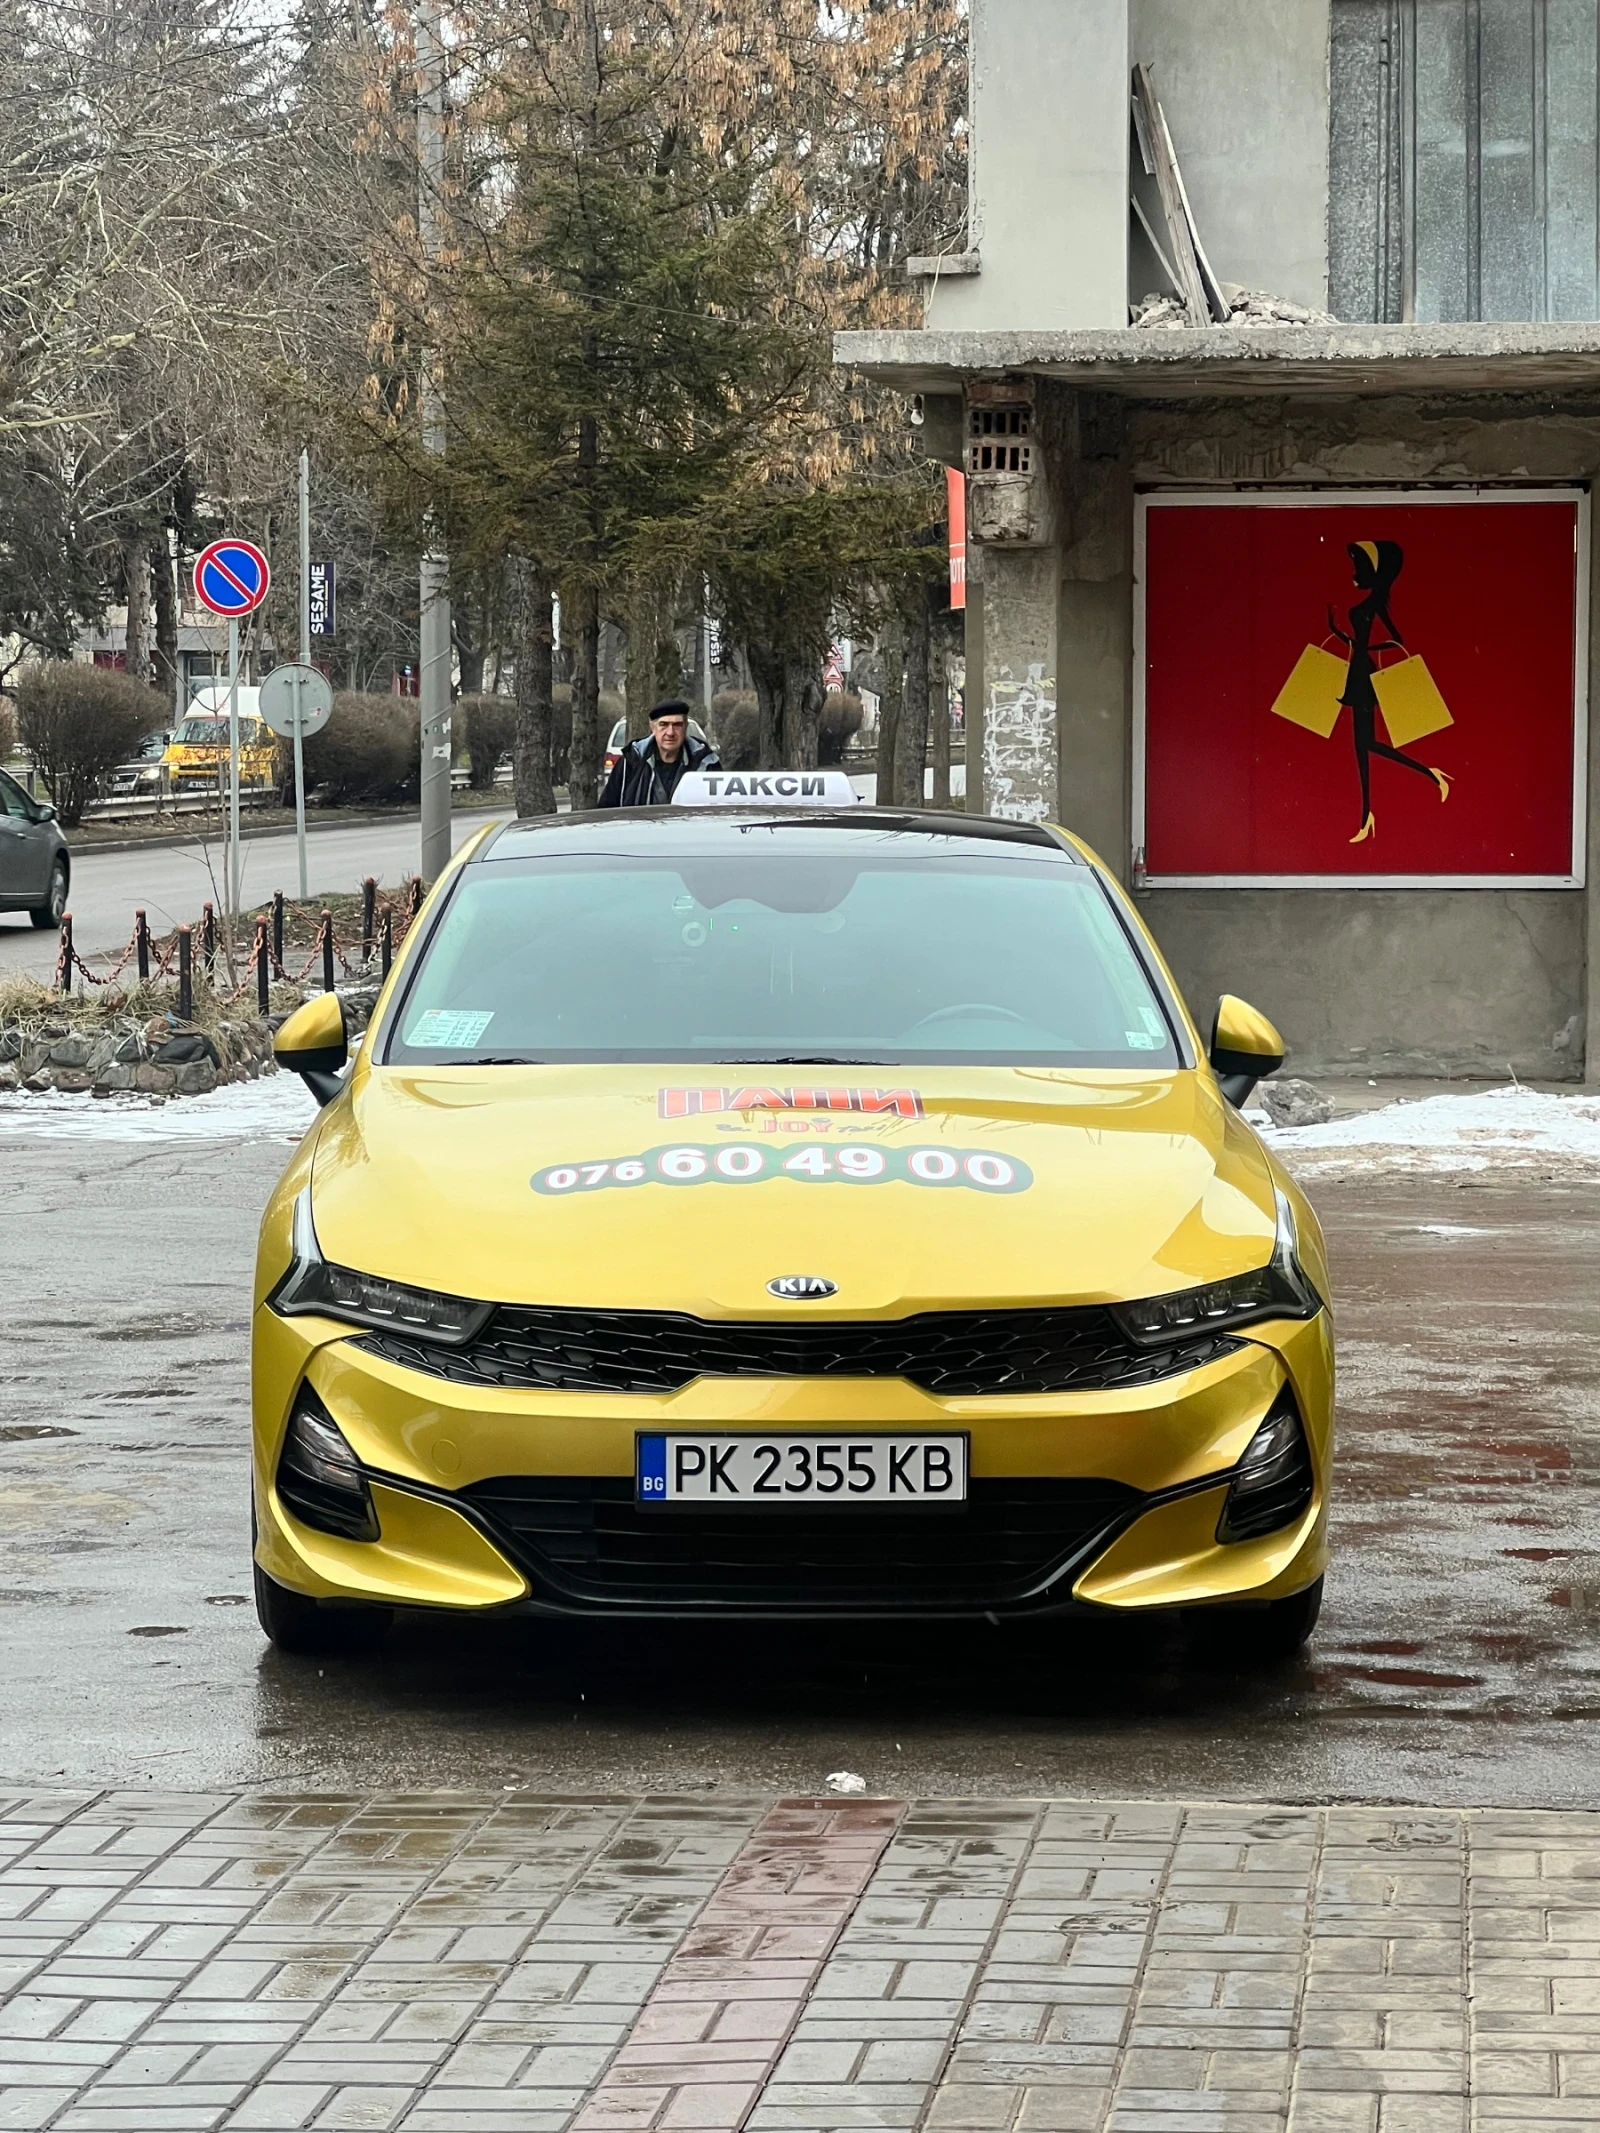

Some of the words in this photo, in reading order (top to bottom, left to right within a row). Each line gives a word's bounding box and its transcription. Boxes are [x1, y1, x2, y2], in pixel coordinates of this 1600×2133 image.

[311, 563, 325, 634] SESAME
[702, 776, 825, 796] ТАКСИ
[659, 1087, 924, 1118] ПАПИ
[758, 1118, 834, 1134] JOY
[545, 1160, 646, 1189] 076
[658, 1147, 763, 1179] 60
[784, 1147, 885, 1177] 49
[908, 1150, 1015, 1187] 00
[779, 1277, 828, 1293] KIA
[675, 1444, 739, 1494] PK
[752, 1444, 877, 1494] 2355
[889, 1444, 953, 1494] KB
[643, 1477, 664, 1491] BG
